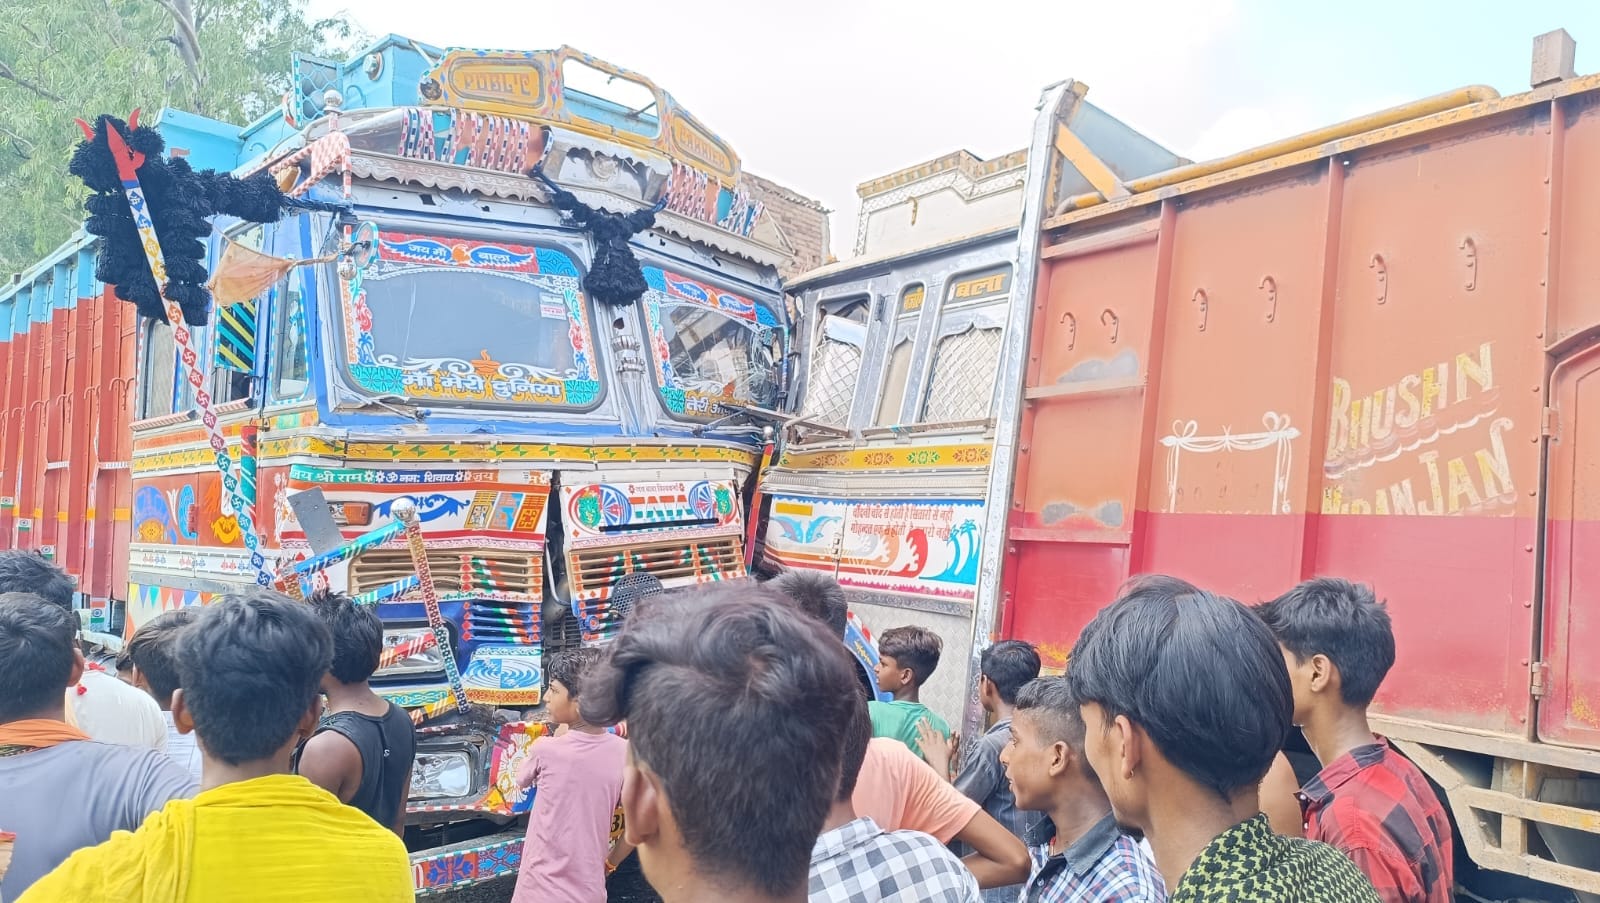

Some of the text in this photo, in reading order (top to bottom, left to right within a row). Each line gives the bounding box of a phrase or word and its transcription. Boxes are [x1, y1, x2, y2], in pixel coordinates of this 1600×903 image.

[440, 374, 485, 391] मेरी
[491, 378, 561, 398] दुनिया
[291, 469, 315, 482] जय
[316, 470, 334, 483] श्री
[337, 472, 362, 483] राम
[424, 471, 454, 483] शिवाय
[1321, 417, 1515, 515] NANJAN
